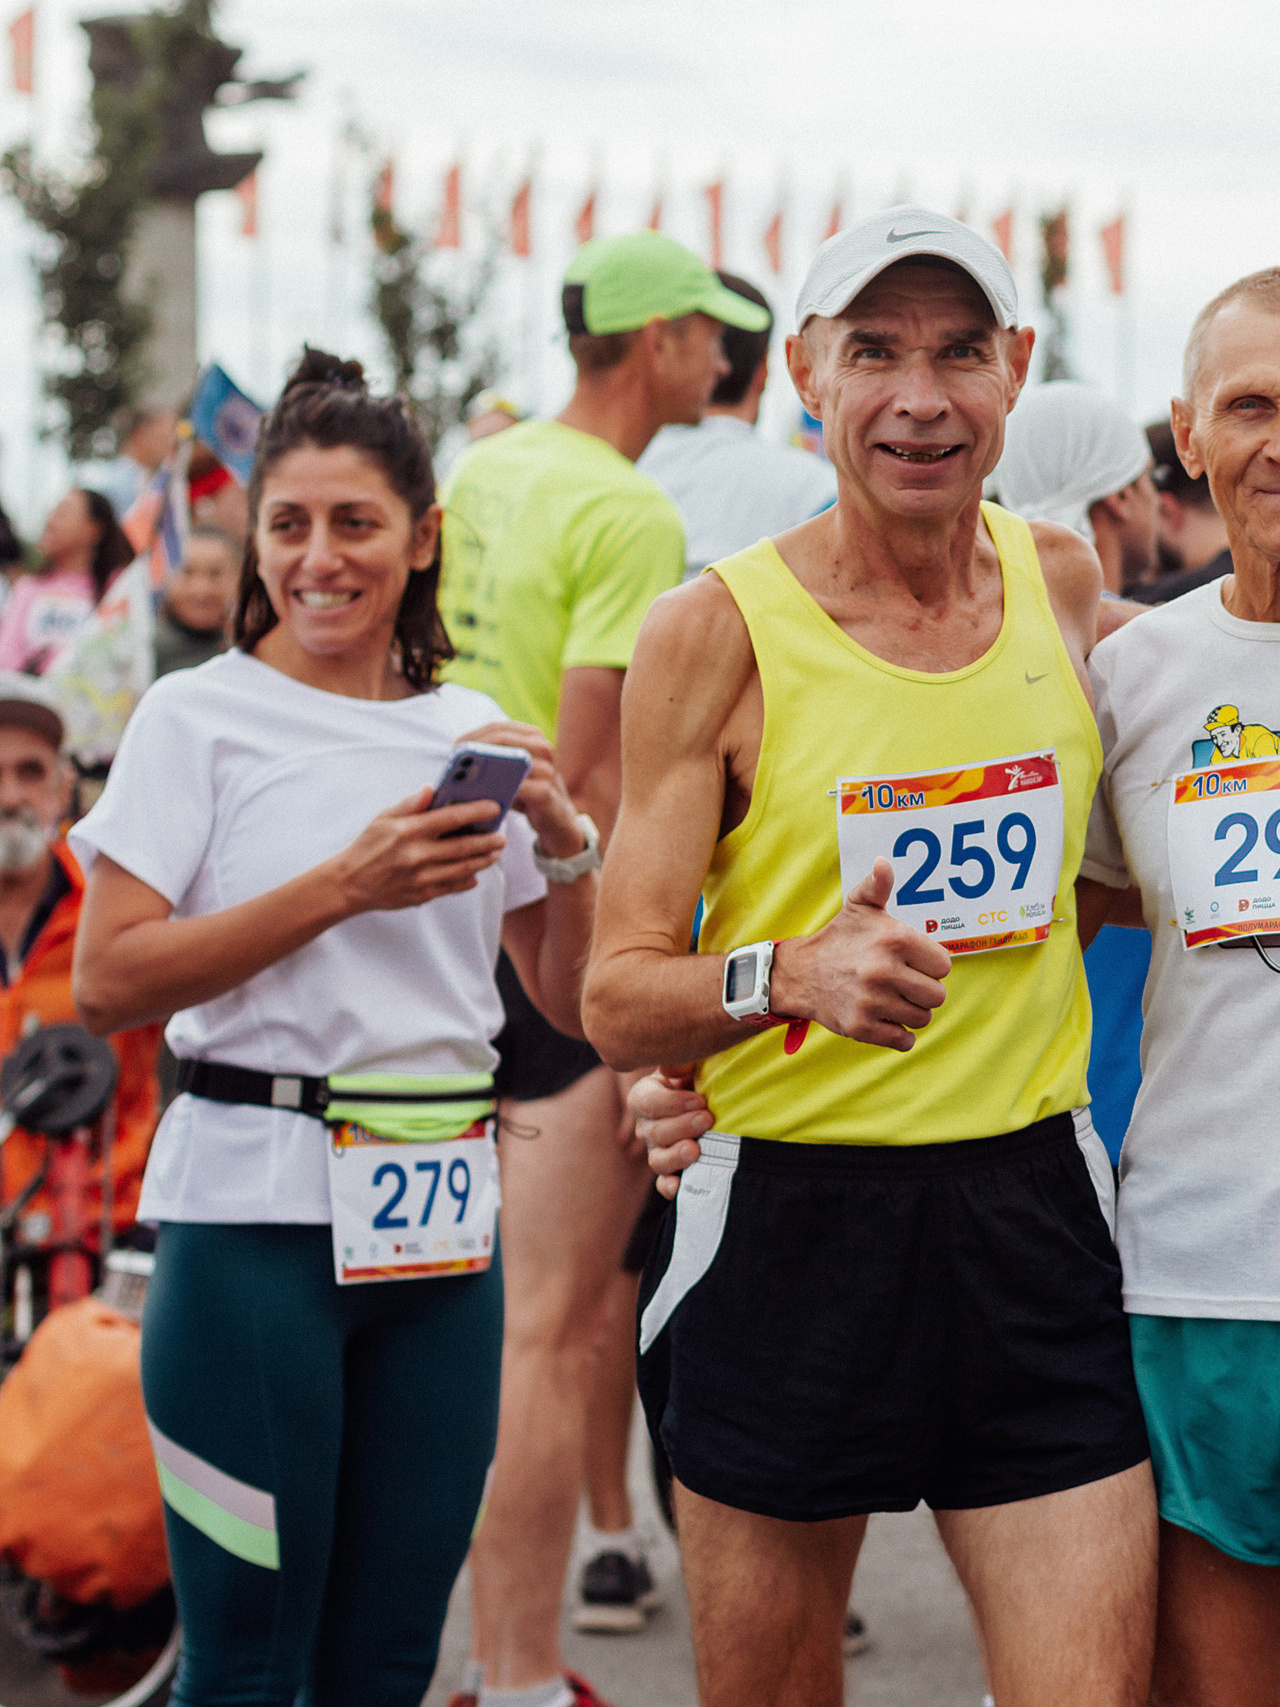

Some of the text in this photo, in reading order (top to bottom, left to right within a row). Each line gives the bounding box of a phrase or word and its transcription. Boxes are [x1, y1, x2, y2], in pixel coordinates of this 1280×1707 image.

[893, 812, 1036, 906] 259
[977, 909, 1009, 925] СТС
[373, 1158, 470, 1230] 279
